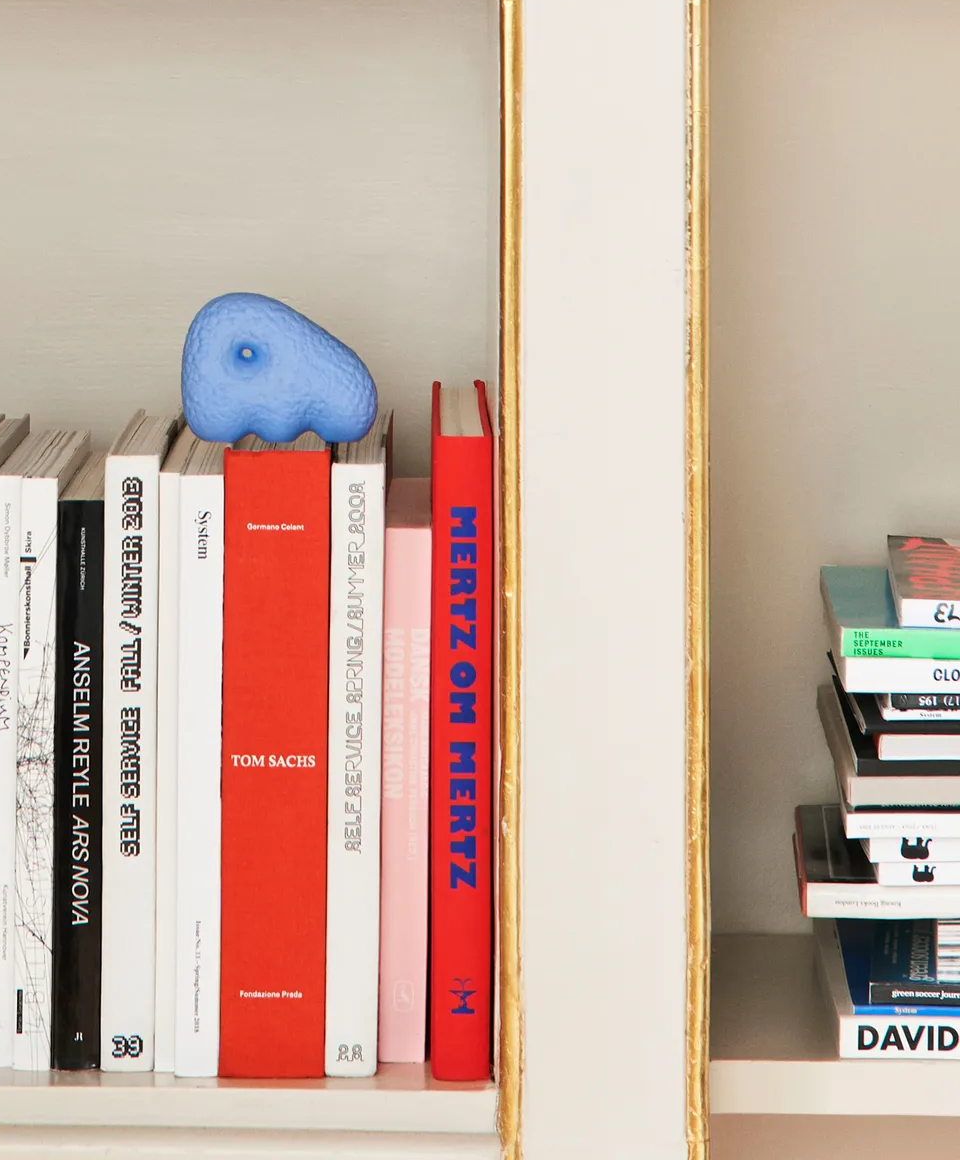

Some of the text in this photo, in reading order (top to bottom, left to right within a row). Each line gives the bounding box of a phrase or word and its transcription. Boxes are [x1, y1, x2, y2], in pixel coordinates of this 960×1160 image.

[195, 511, 210, 559] System
[21, 566, 31, 646] Bonnierskonsthall
[73, 641, 90, 730] ANSELM
[120, 477, 143, 856] SELF SERVICE FALL WINTER 2013
[409, 628, 430, 704] DANSK
[384, 627, 405, 799] MODELEKSIKON
[450, 506, 477, 889] MERTZ OM MERTZ
[919, 696, 937, 706] 195
[73, 730, 89, 807] REYLE
[231, 755, 315, 767] TOM SACHS
[345, 710, 362, 798] SERVICE
[72, 815, 89, 861] ARS
[345, 800, 362, 854] SELF
[72, 865, 89, 925] NOVA
[240, 990, 279, 998] Fondazione
[892, 990, 914, 998] green
[112, 1035, 143, 1058] 39
[858, 1025, 959, 1051] DAVID
